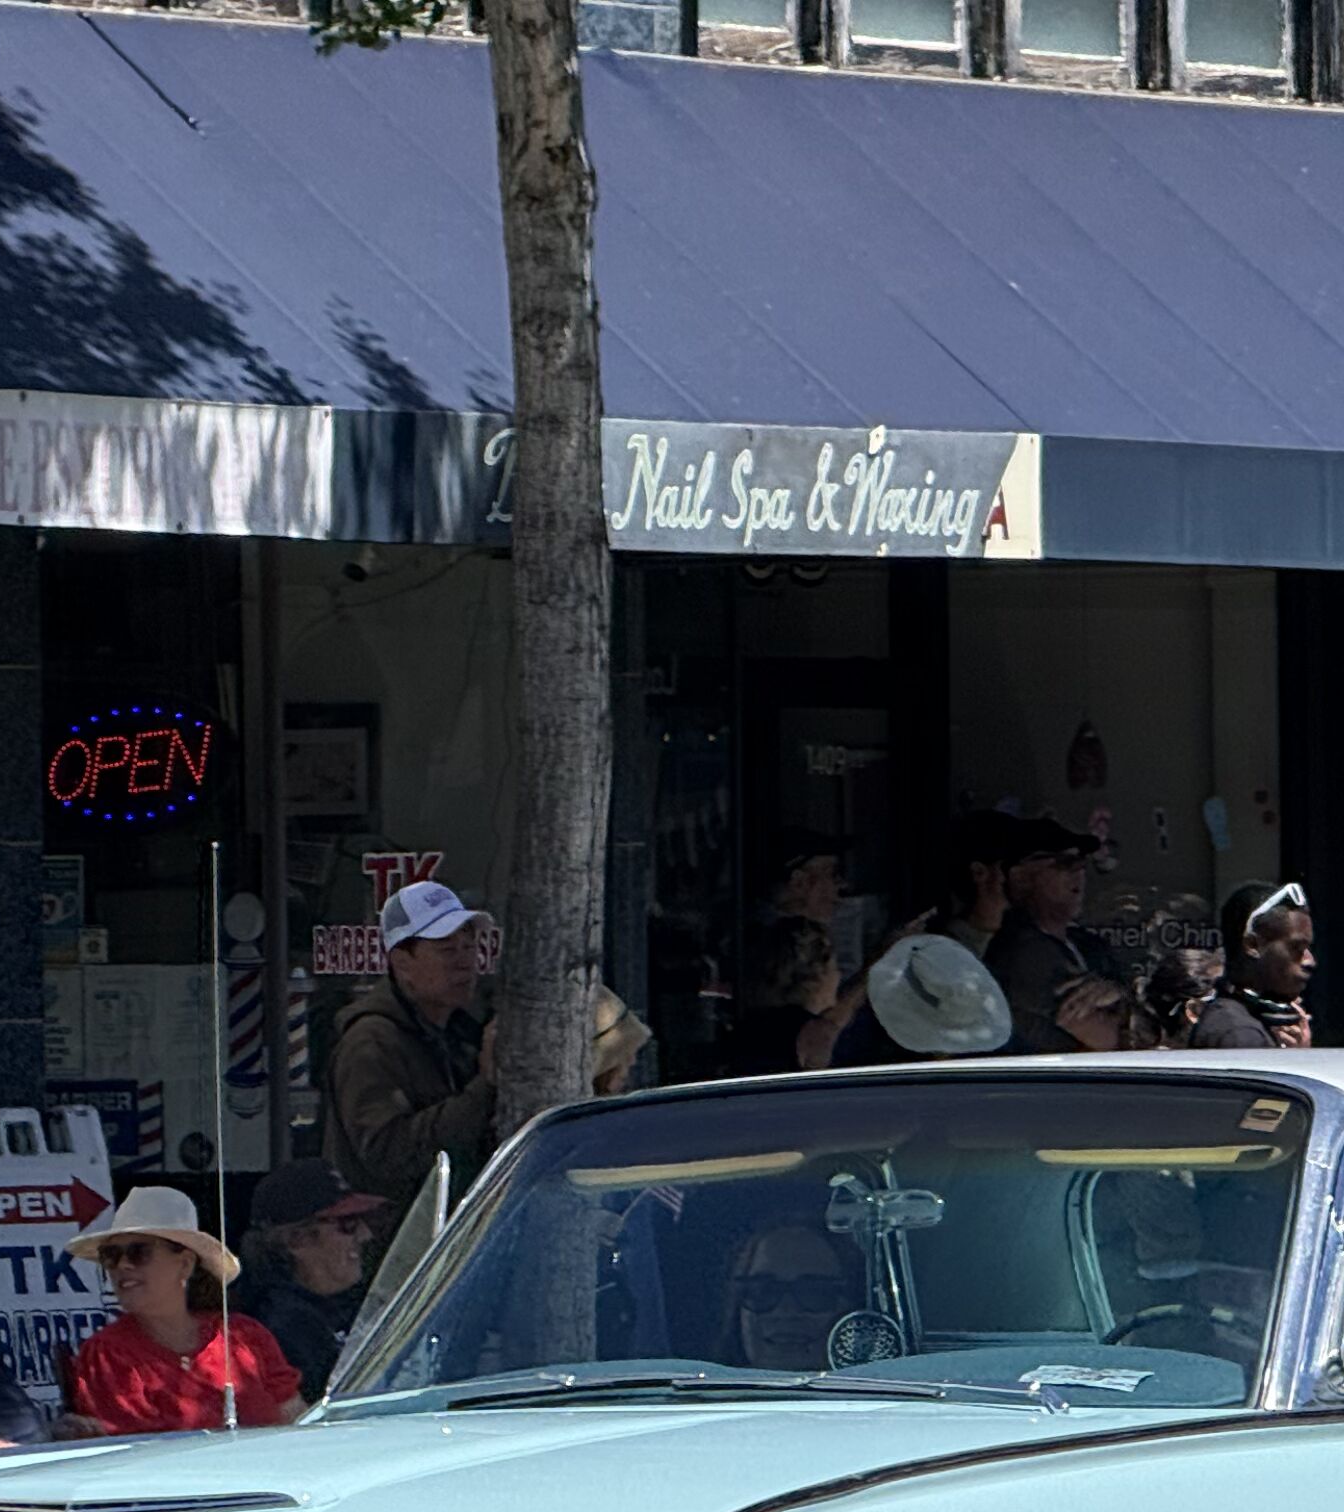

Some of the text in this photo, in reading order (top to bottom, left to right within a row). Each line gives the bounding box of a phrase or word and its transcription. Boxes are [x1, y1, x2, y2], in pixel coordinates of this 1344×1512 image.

[612, 433, 715, 530] Nail
[722, 448, 794, 547] Spa
[806, 441, 842, 532] &
[844, 449, 979, 556] Waxing
[49, 724, 212, 801] OPEN
[312, 925, 389, 974] BARBE
[1087, 922, 1145, 948] niel
